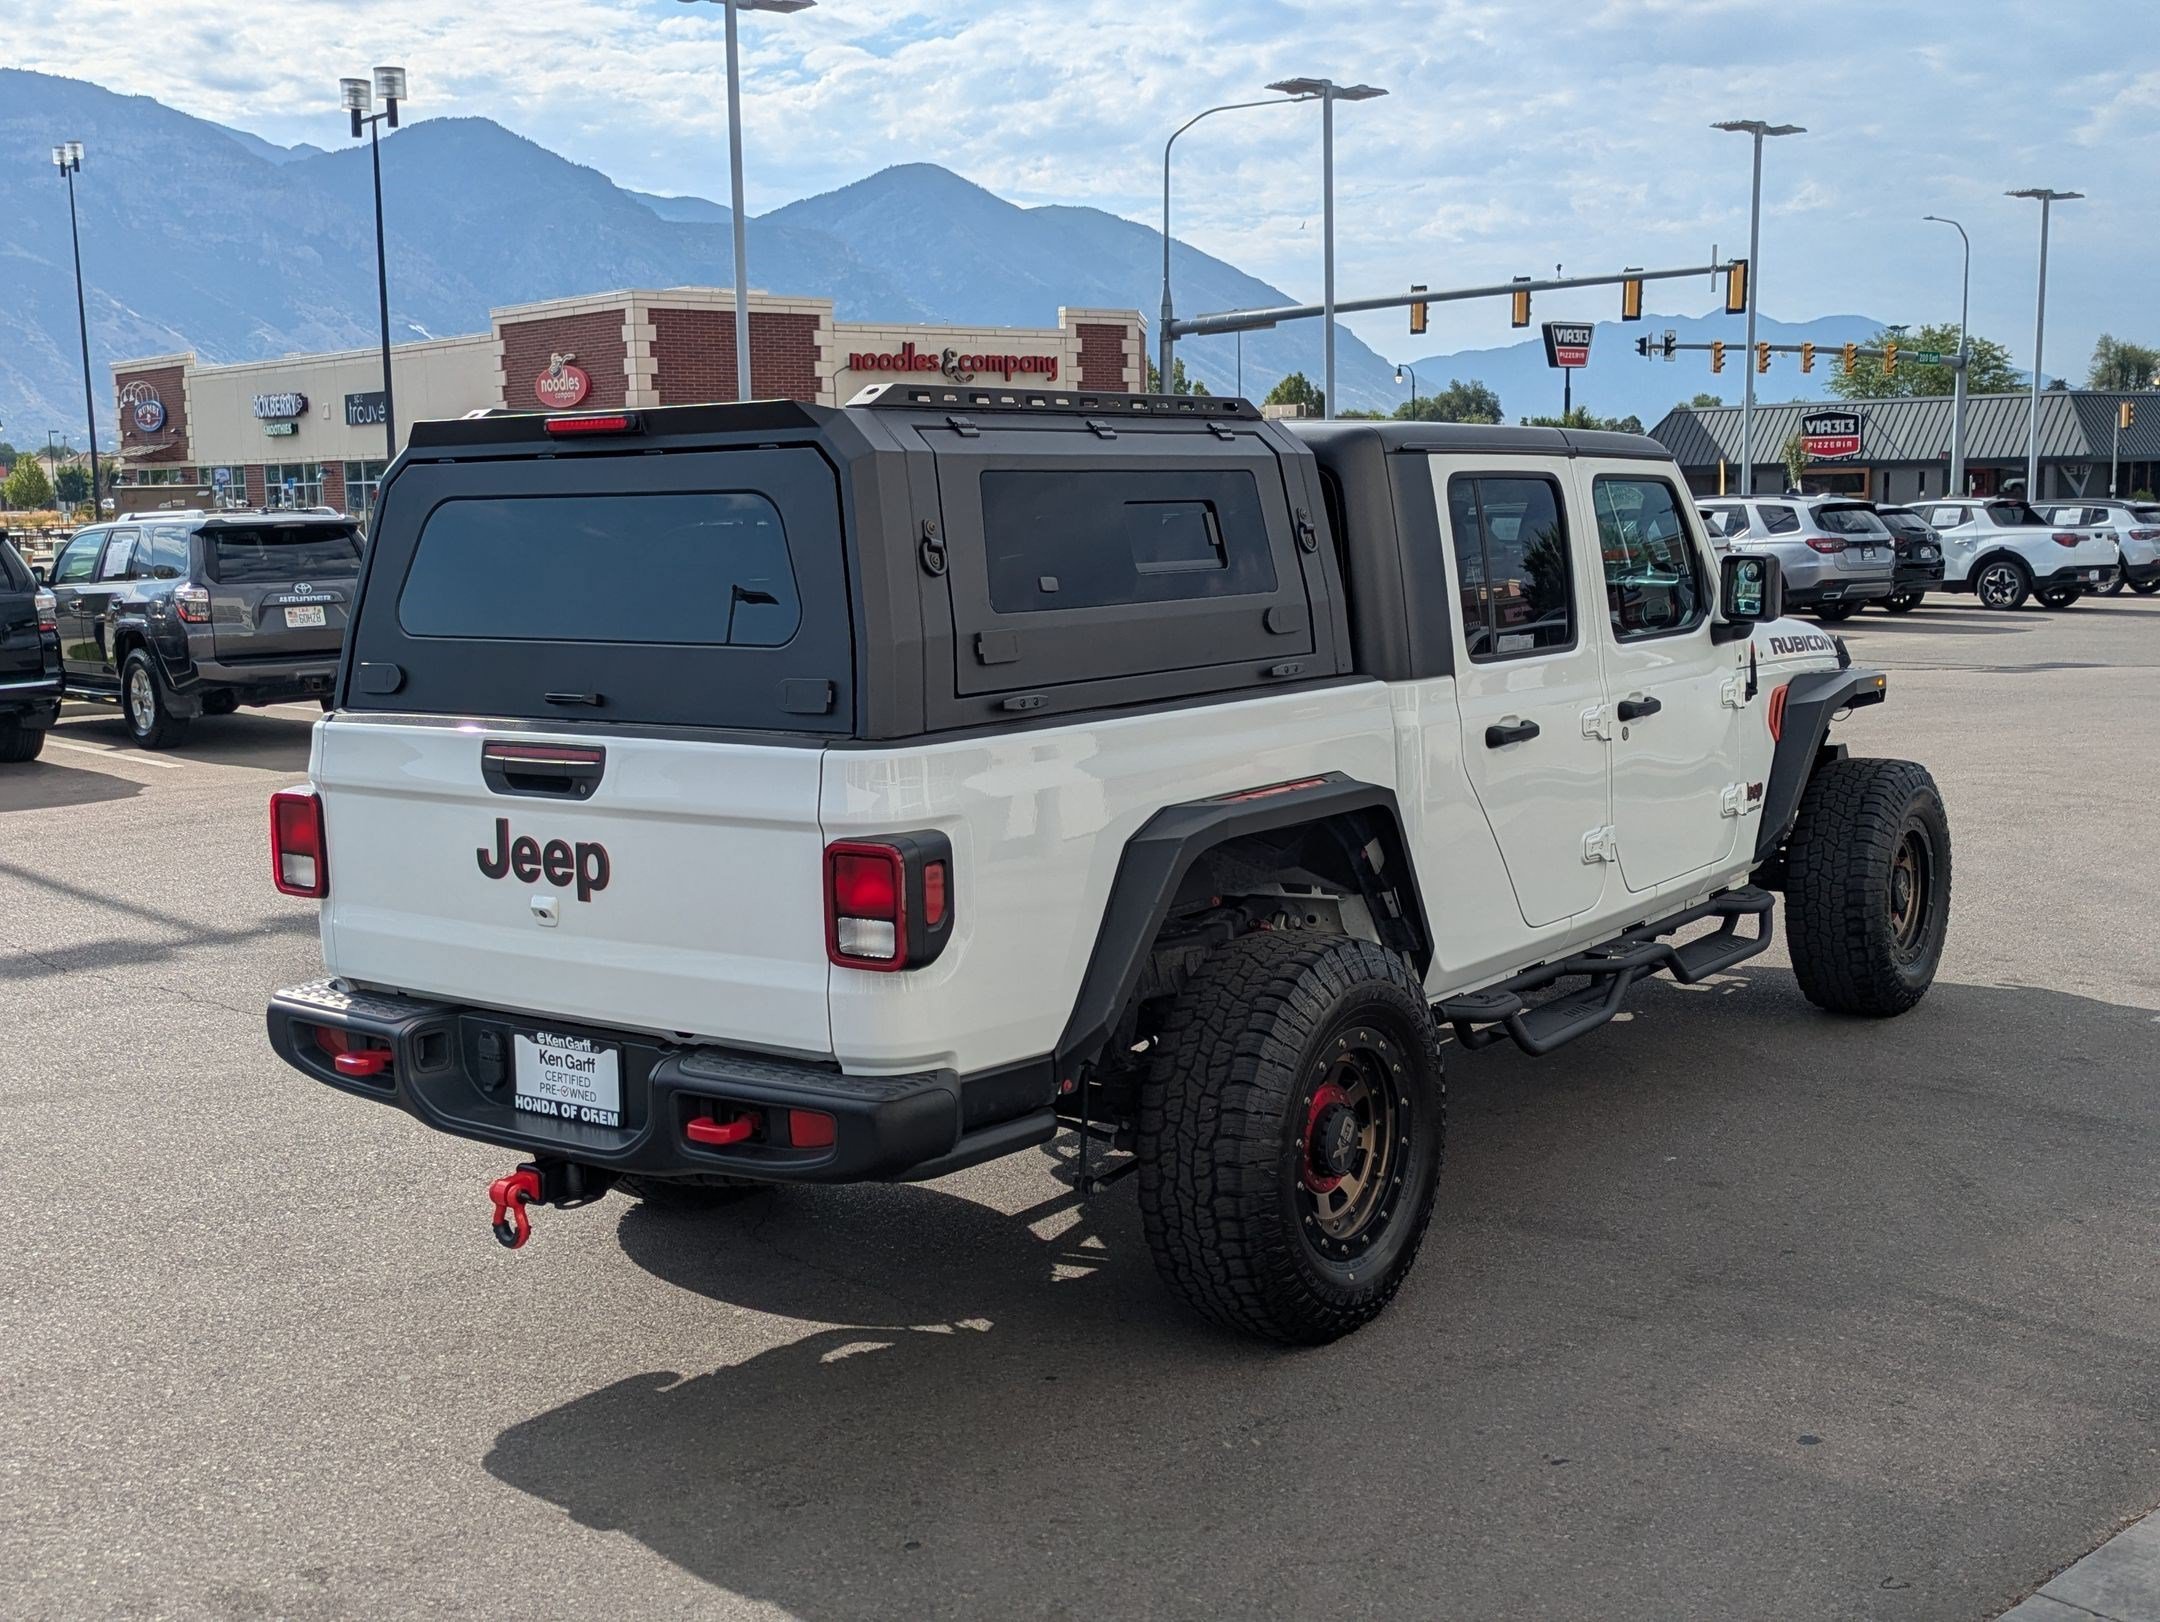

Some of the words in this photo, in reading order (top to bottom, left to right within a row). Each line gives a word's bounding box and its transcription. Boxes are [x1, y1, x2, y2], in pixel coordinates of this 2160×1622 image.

[849, 342, 939, 371] noodles
[958, 355, 1058, 382] company
[541, 369, 580, 392] noodles
[253, 393, 297, 418] ROXBERRY
[348, 402, 386, 423] trouvé
[263, 422, 293, 435] SMOOTHIES
[1808, 441, 1853, 449] PIZZERIA
[1769, 634, 1834, 655] RUBICON
[476, 817, 610, 903] Jeep
[545, 1033, 565, 1048] Ken
[565, 1036, 592, 1052] Garff
[539, 1048, 563, 1068] Ken
[565, 1053, 596, 1074] Garff
[544, 1070, 592, 1088] CERTIFIED
[515, 1094, 558, 1116] HONDA
[561, 1103, 577, 1119] OF
